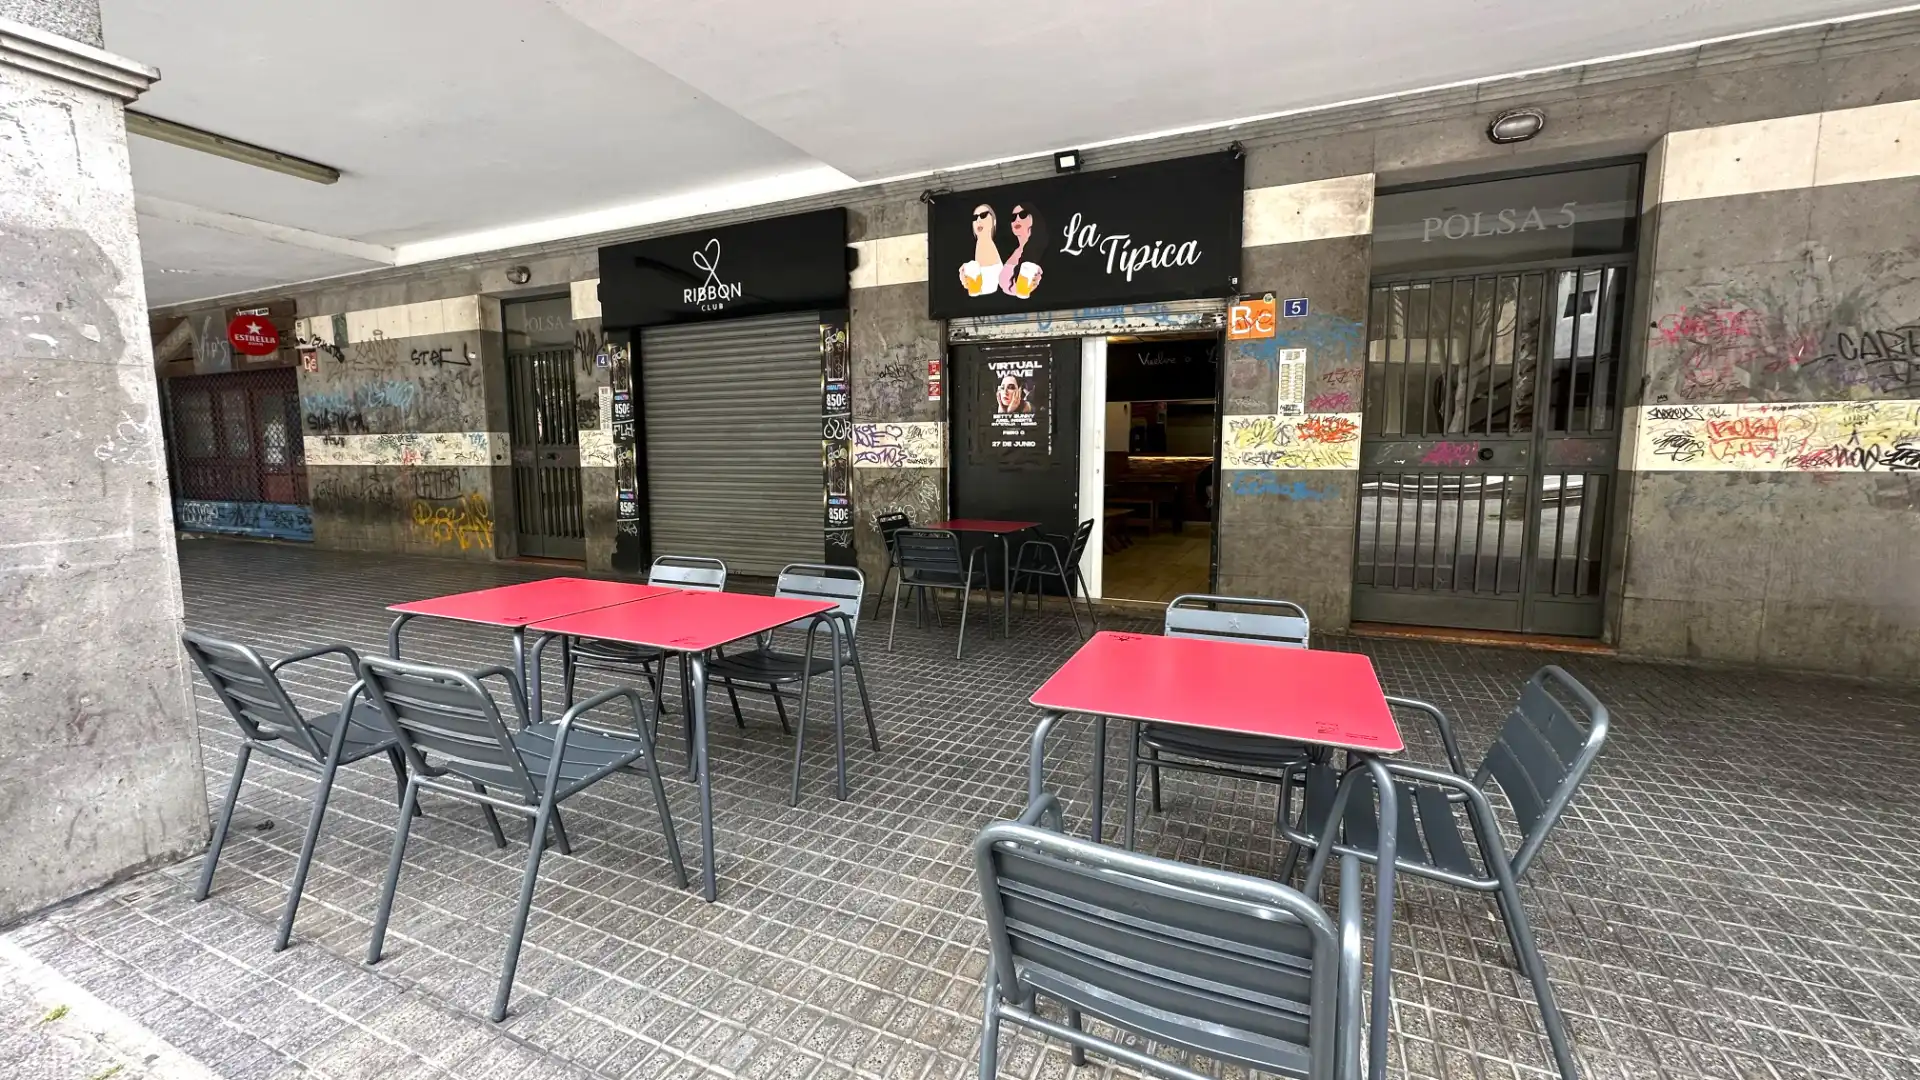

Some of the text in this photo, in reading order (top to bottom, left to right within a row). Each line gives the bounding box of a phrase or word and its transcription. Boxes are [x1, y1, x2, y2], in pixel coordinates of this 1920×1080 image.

[1421, 201, 1578, 243] POLSA 5
[1060, 212, 1202, 282] La Típica
[683, 281, 742, 305] RIBBON
[701, 302, 724, 312] CLUB
[1291, 301, 1301, 315] 5
[234, 333, 276, 344] ESTRELLA
[988, 360, 1043, 370] VIRTUAL
[995, 369, 1034, 378] WAVE
